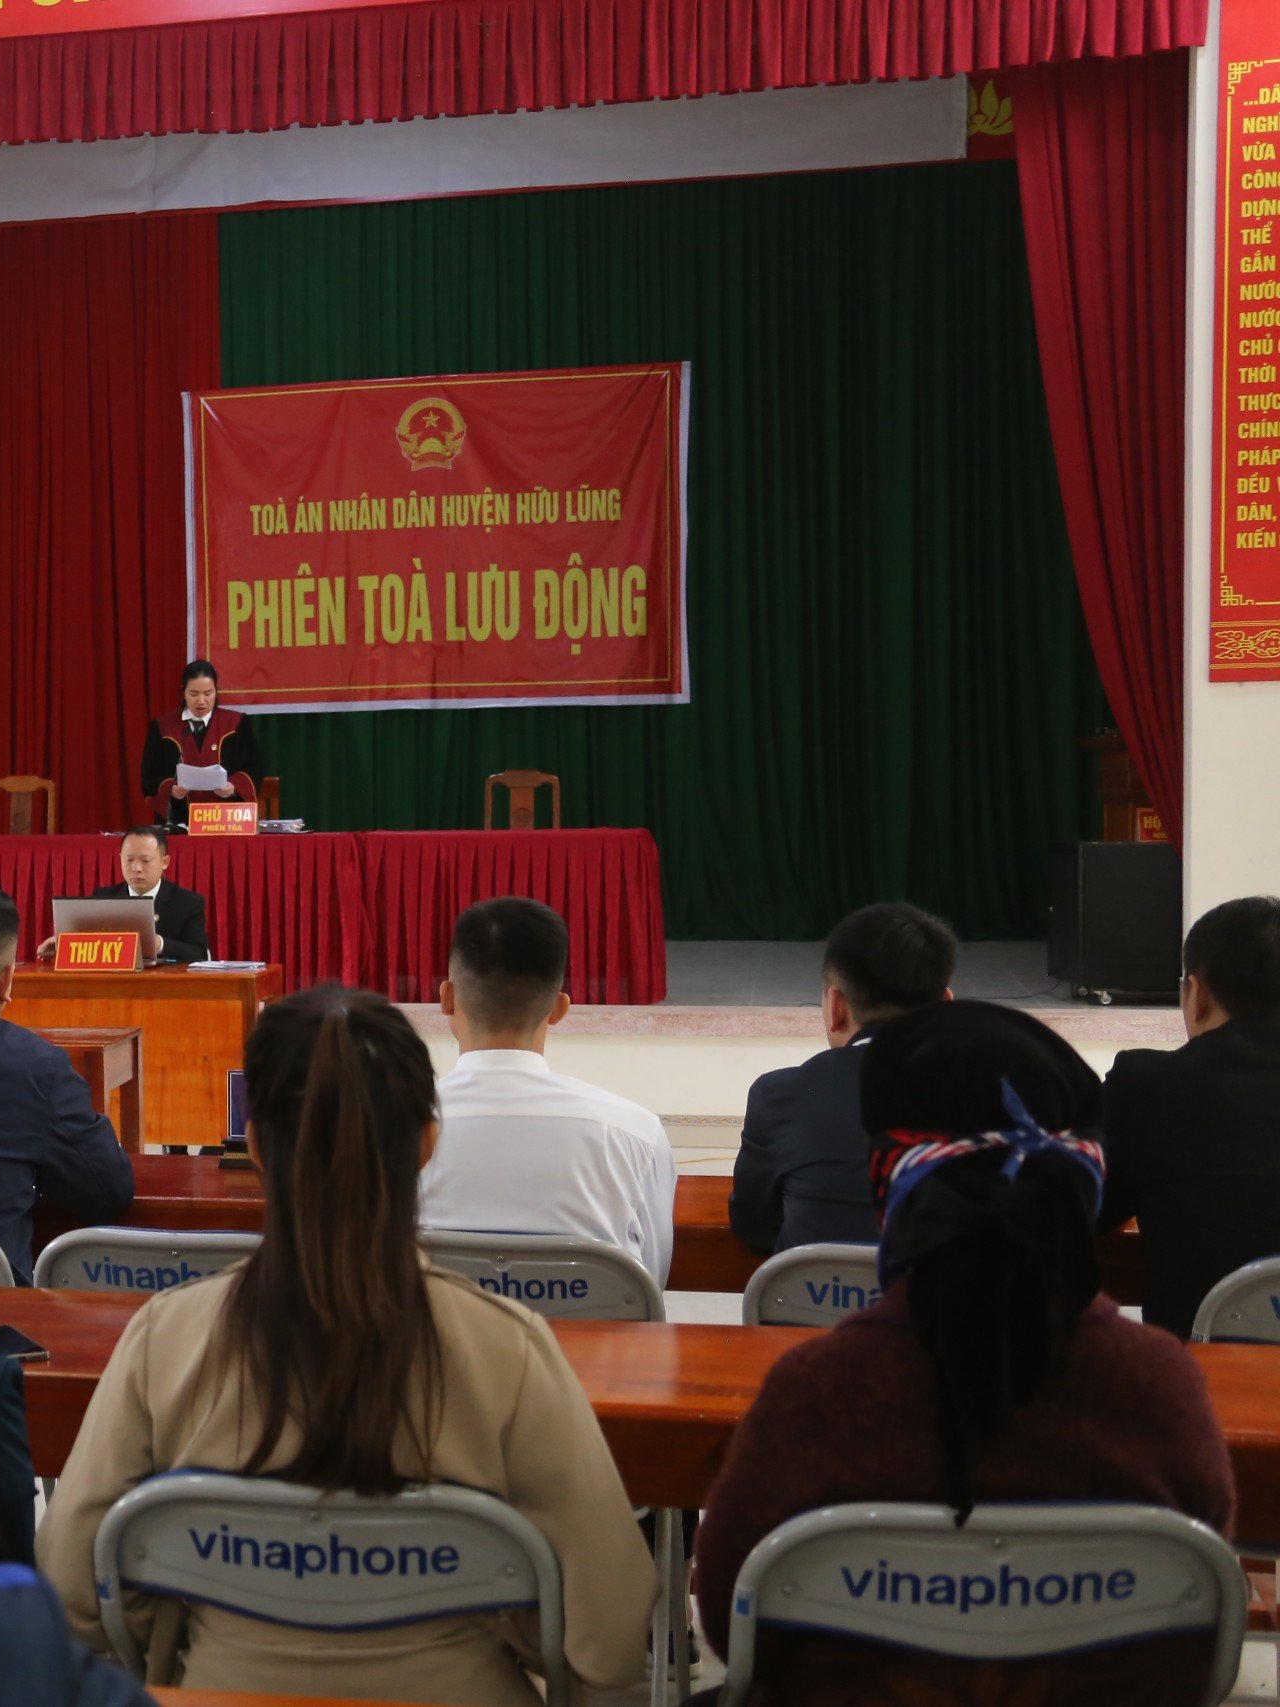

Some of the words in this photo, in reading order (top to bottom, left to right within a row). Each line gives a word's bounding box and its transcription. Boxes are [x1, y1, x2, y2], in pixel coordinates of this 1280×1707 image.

[1242, 112, 1280, 134] NGH
[1242, 141, 1275, 162] VỪA
[1241, 169, 1280, 190] CÔN
[1241, 198, 1280, 220] DỰN
[1240, 250, 1276, 273] GẮN
[1239, 333, 1273, 356] CHỦ
[1238, 363, 1276, 384] THỜI
[1238, 392, 1280, 414] THỰC
[1238, 419, 1280, 439] CHÍN
[1237, 446, 1280, 467] PHÁP
[250, 497, 288, 536] TOÀ
[295, 497, 323, 533] ÁN
[329, 493, 386, 531] NHÂN
[393, 491, 435, 529] DÂN
[442, 487, 509, 533] HUYỆN
[517, 486, 559, 524] HỮU
[566, 484, 621, 522] LŨNG
[1237, 502, 1277, 522] DÂN,
[1236, 527, 1276, 548] KIẾN
[227, 563, 346, 649] PHIÊN
[358, 558, 432, 644] TOÀ
[445, 564, 519, 642] LƯU
[533, 552, 647, 655] ĐỘNG
[193, 805, 221, 822] CHỦ
[69, 939, 101, 964] THƯ
[102, 936, 123, 963] KÝ
[82, 1256, 217, 1291] vinaph
[189, 1525, 460, 1578] vinaphone
[841, 1560, 1136, 1613] vinaphone
